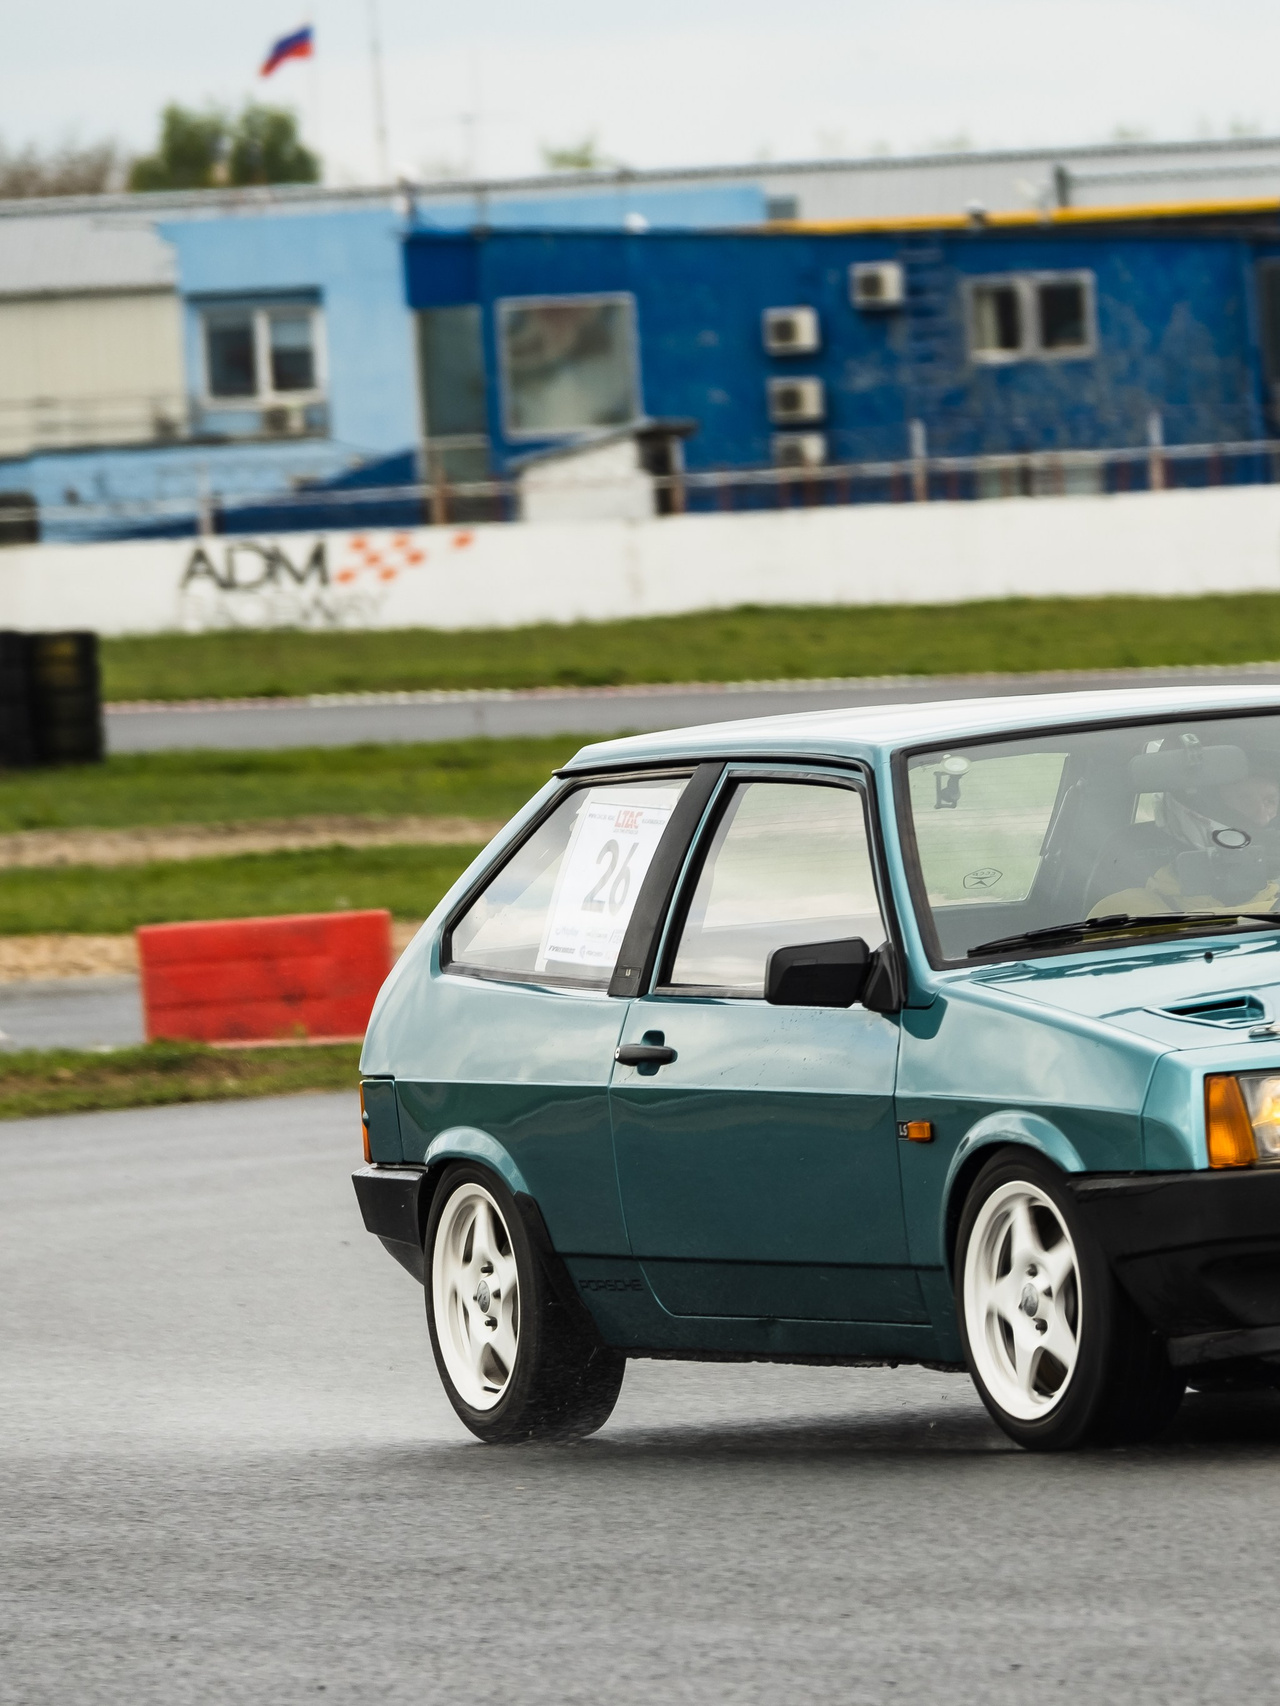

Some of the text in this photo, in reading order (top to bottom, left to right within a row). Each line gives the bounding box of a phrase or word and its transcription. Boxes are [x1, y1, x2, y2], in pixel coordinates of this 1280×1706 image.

[180, 540, 330, 590] ADM
[581, 838, 640, 917] 26
[578, 1279, 644, 1292] PORSCHE
